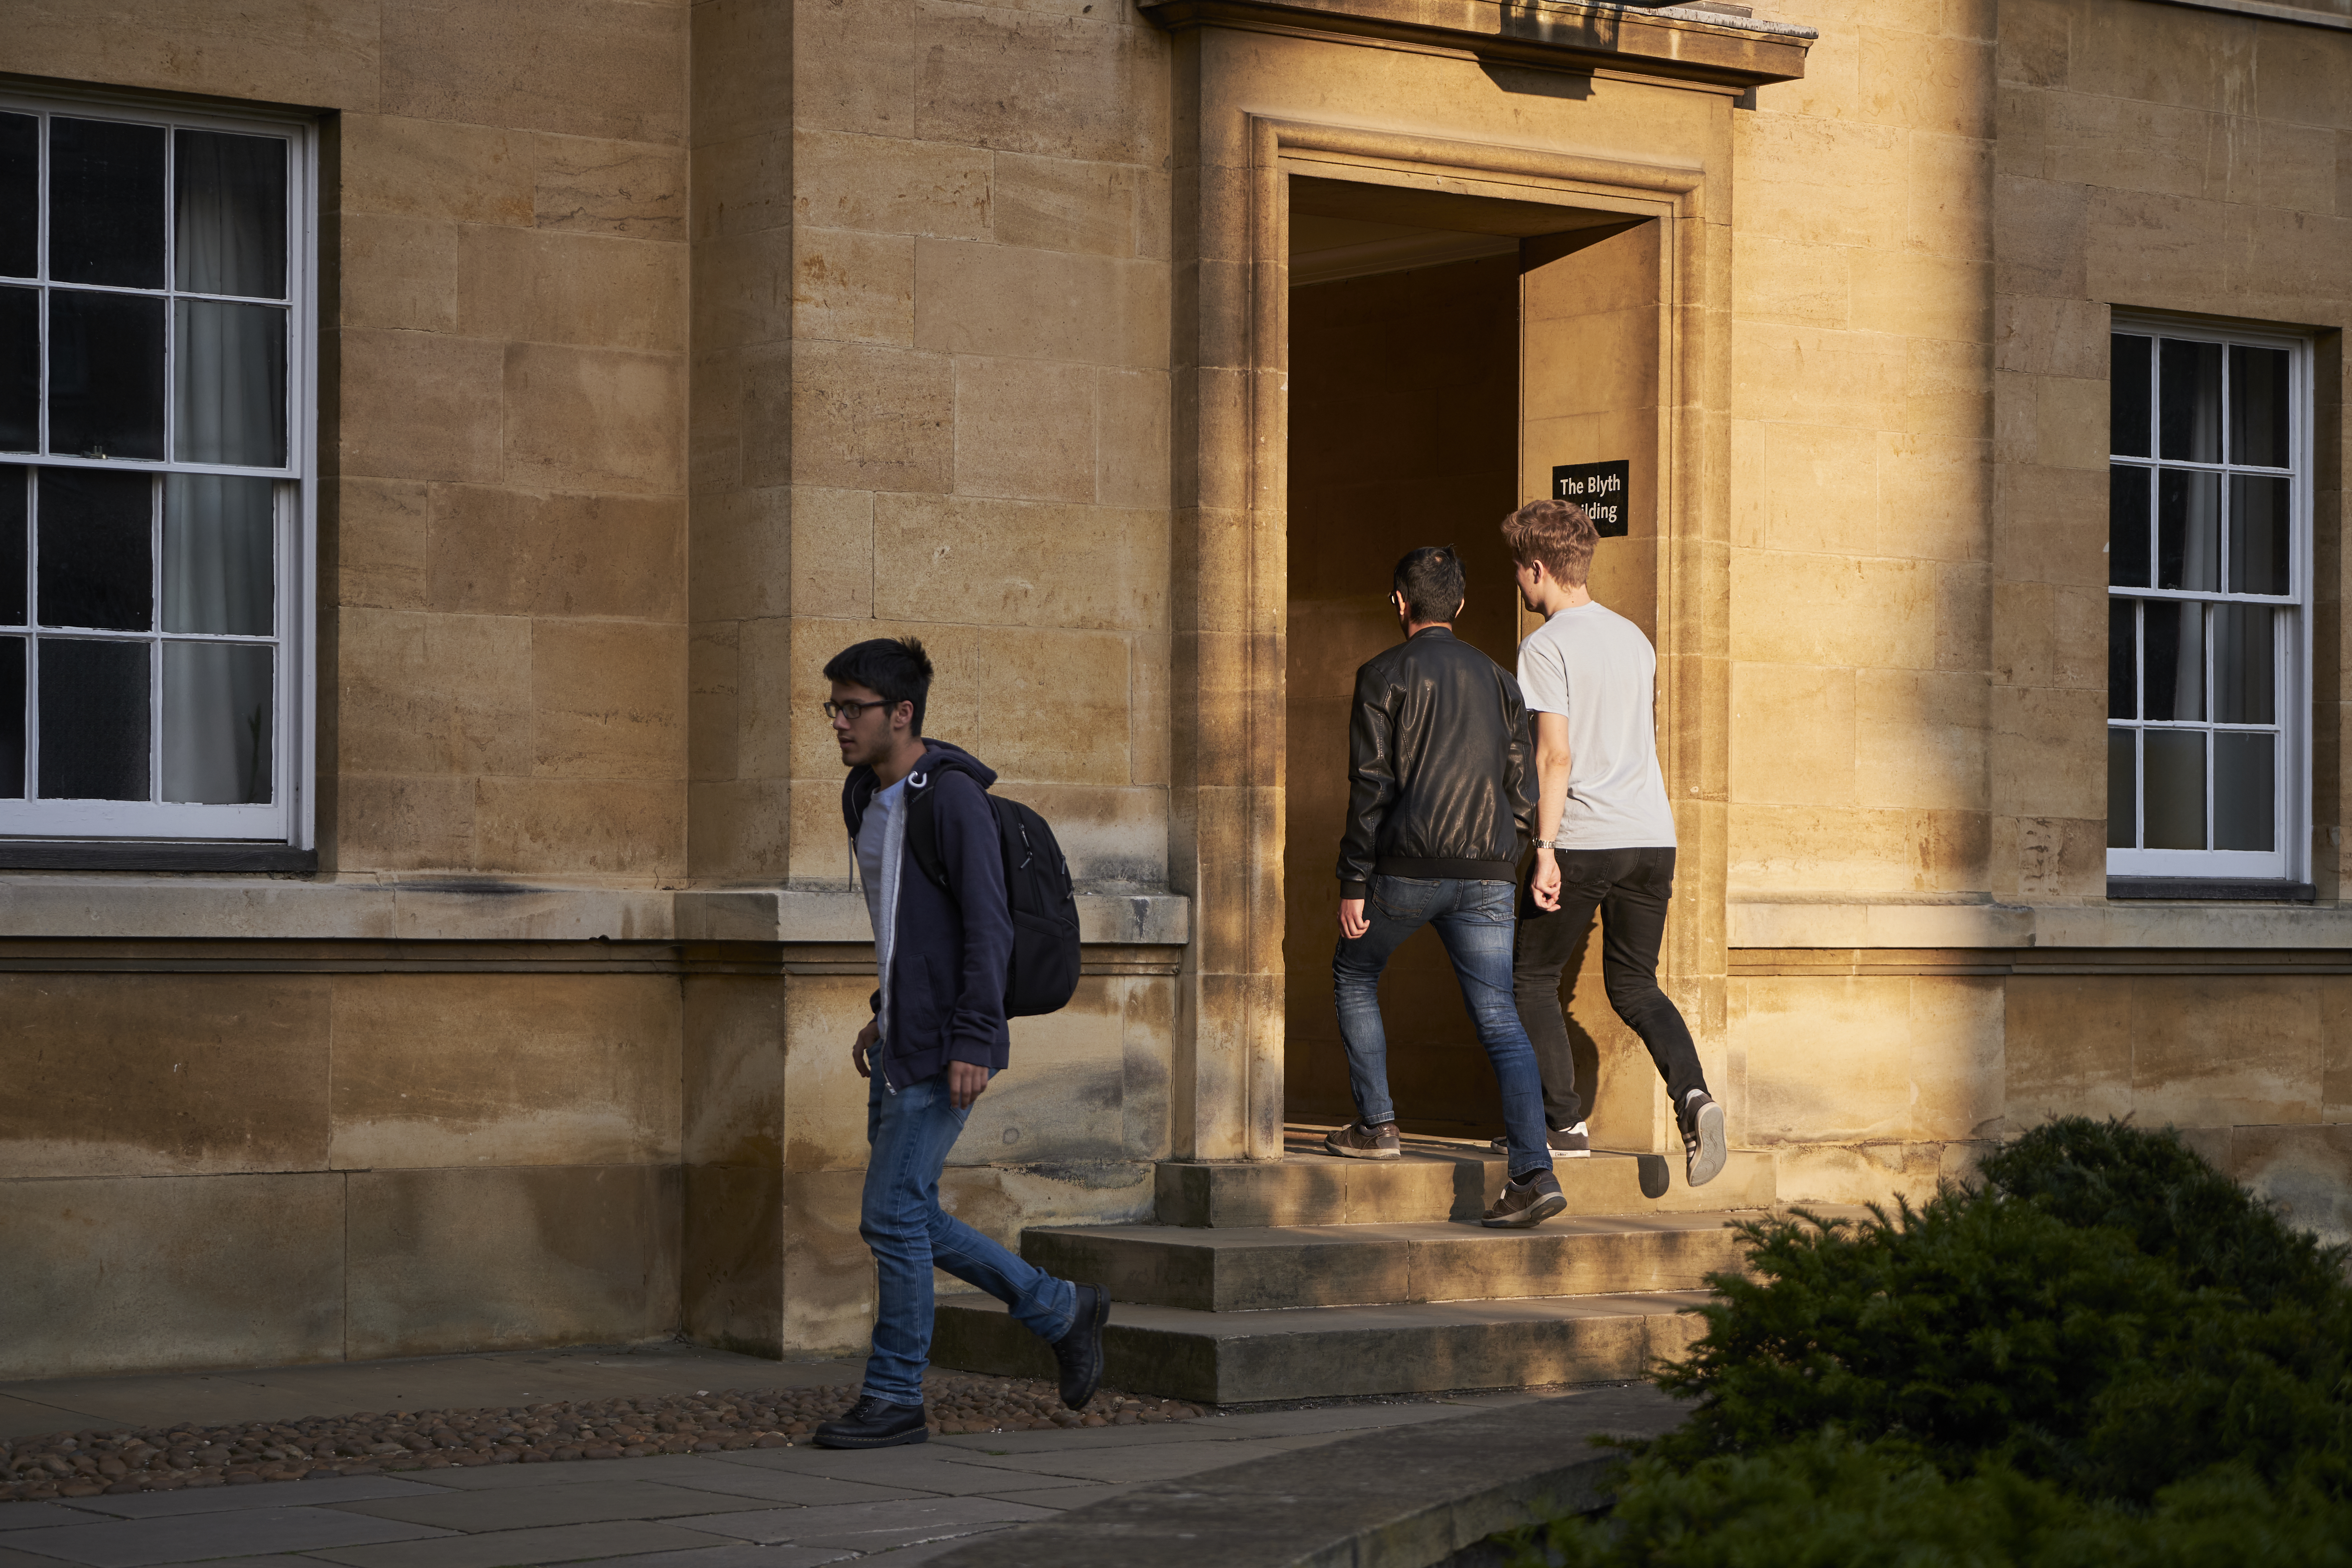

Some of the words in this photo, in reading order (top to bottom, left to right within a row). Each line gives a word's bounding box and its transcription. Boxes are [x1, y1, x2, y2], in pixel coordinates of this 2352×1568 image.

[1560, 477, 1584, 495] The
[1588, 474, 1620, 497] Blyth
[1581, 502, 1617, 523] lding
